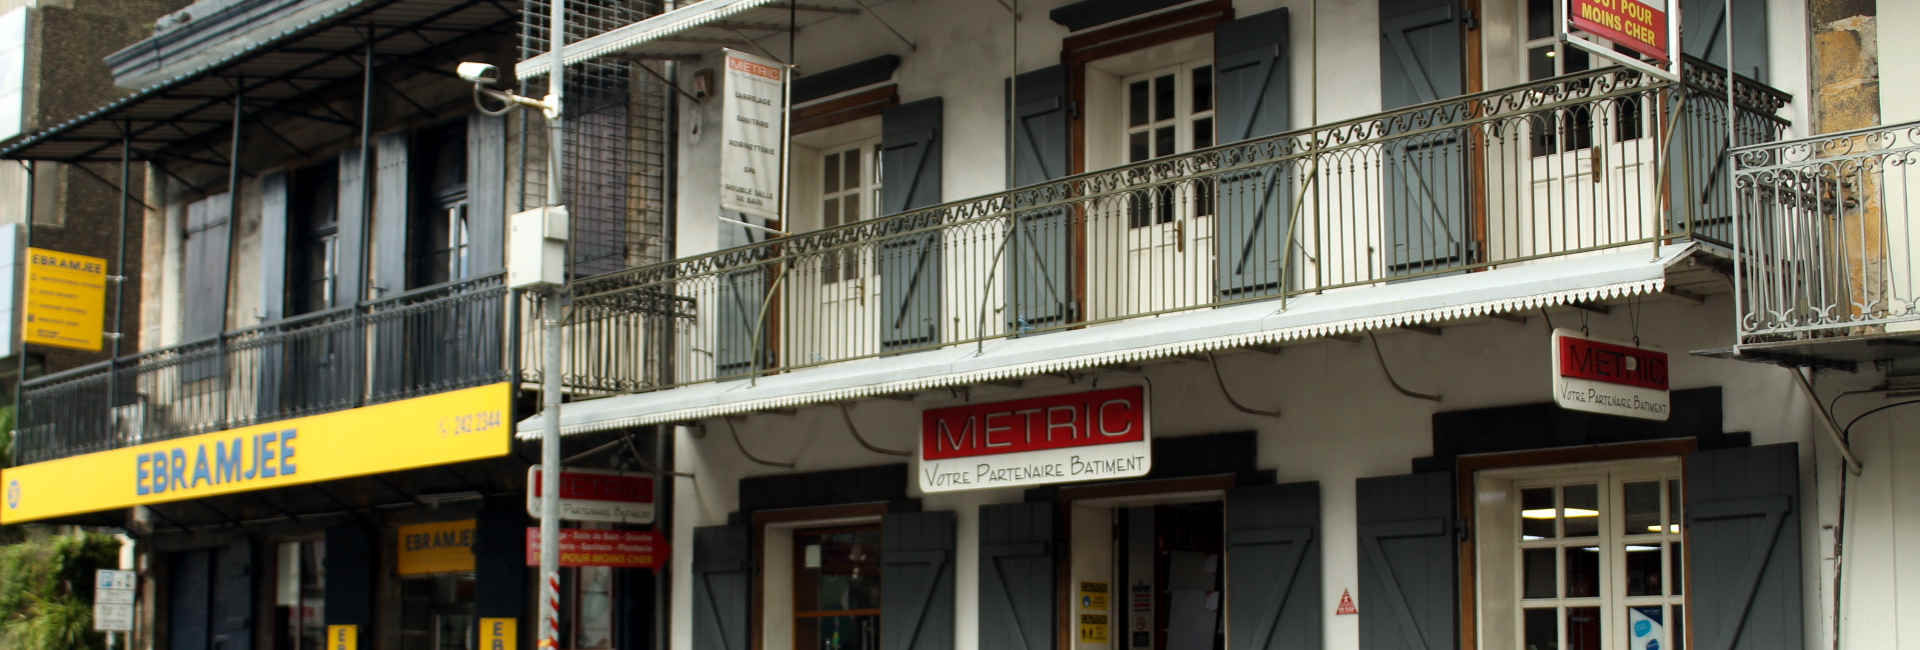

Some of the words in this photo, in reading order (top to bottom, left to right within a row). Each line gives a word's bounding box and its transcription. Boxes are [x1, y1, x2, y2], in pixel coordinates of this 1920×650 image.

[1582, 3, 1622, 32] MOINS
[1625, 20, 1656, 47] CHER
[1621, 0, 1653, 25] POUR
[32, 255, 102, 274] EBRAMJEE
[1569, 345, 1666, 385] METRIC
[1561, 382, 1586, 403] VOTRE
[935, 399, 1133, 453] METRIC
[136, 429, 298, 495] EBRAMJEE
[925, 464, 971, 487] VOTRE
[976, 462, 1065, 484] PARTENAIRE
[1071, 455, 1145, 476] BATIMENT
